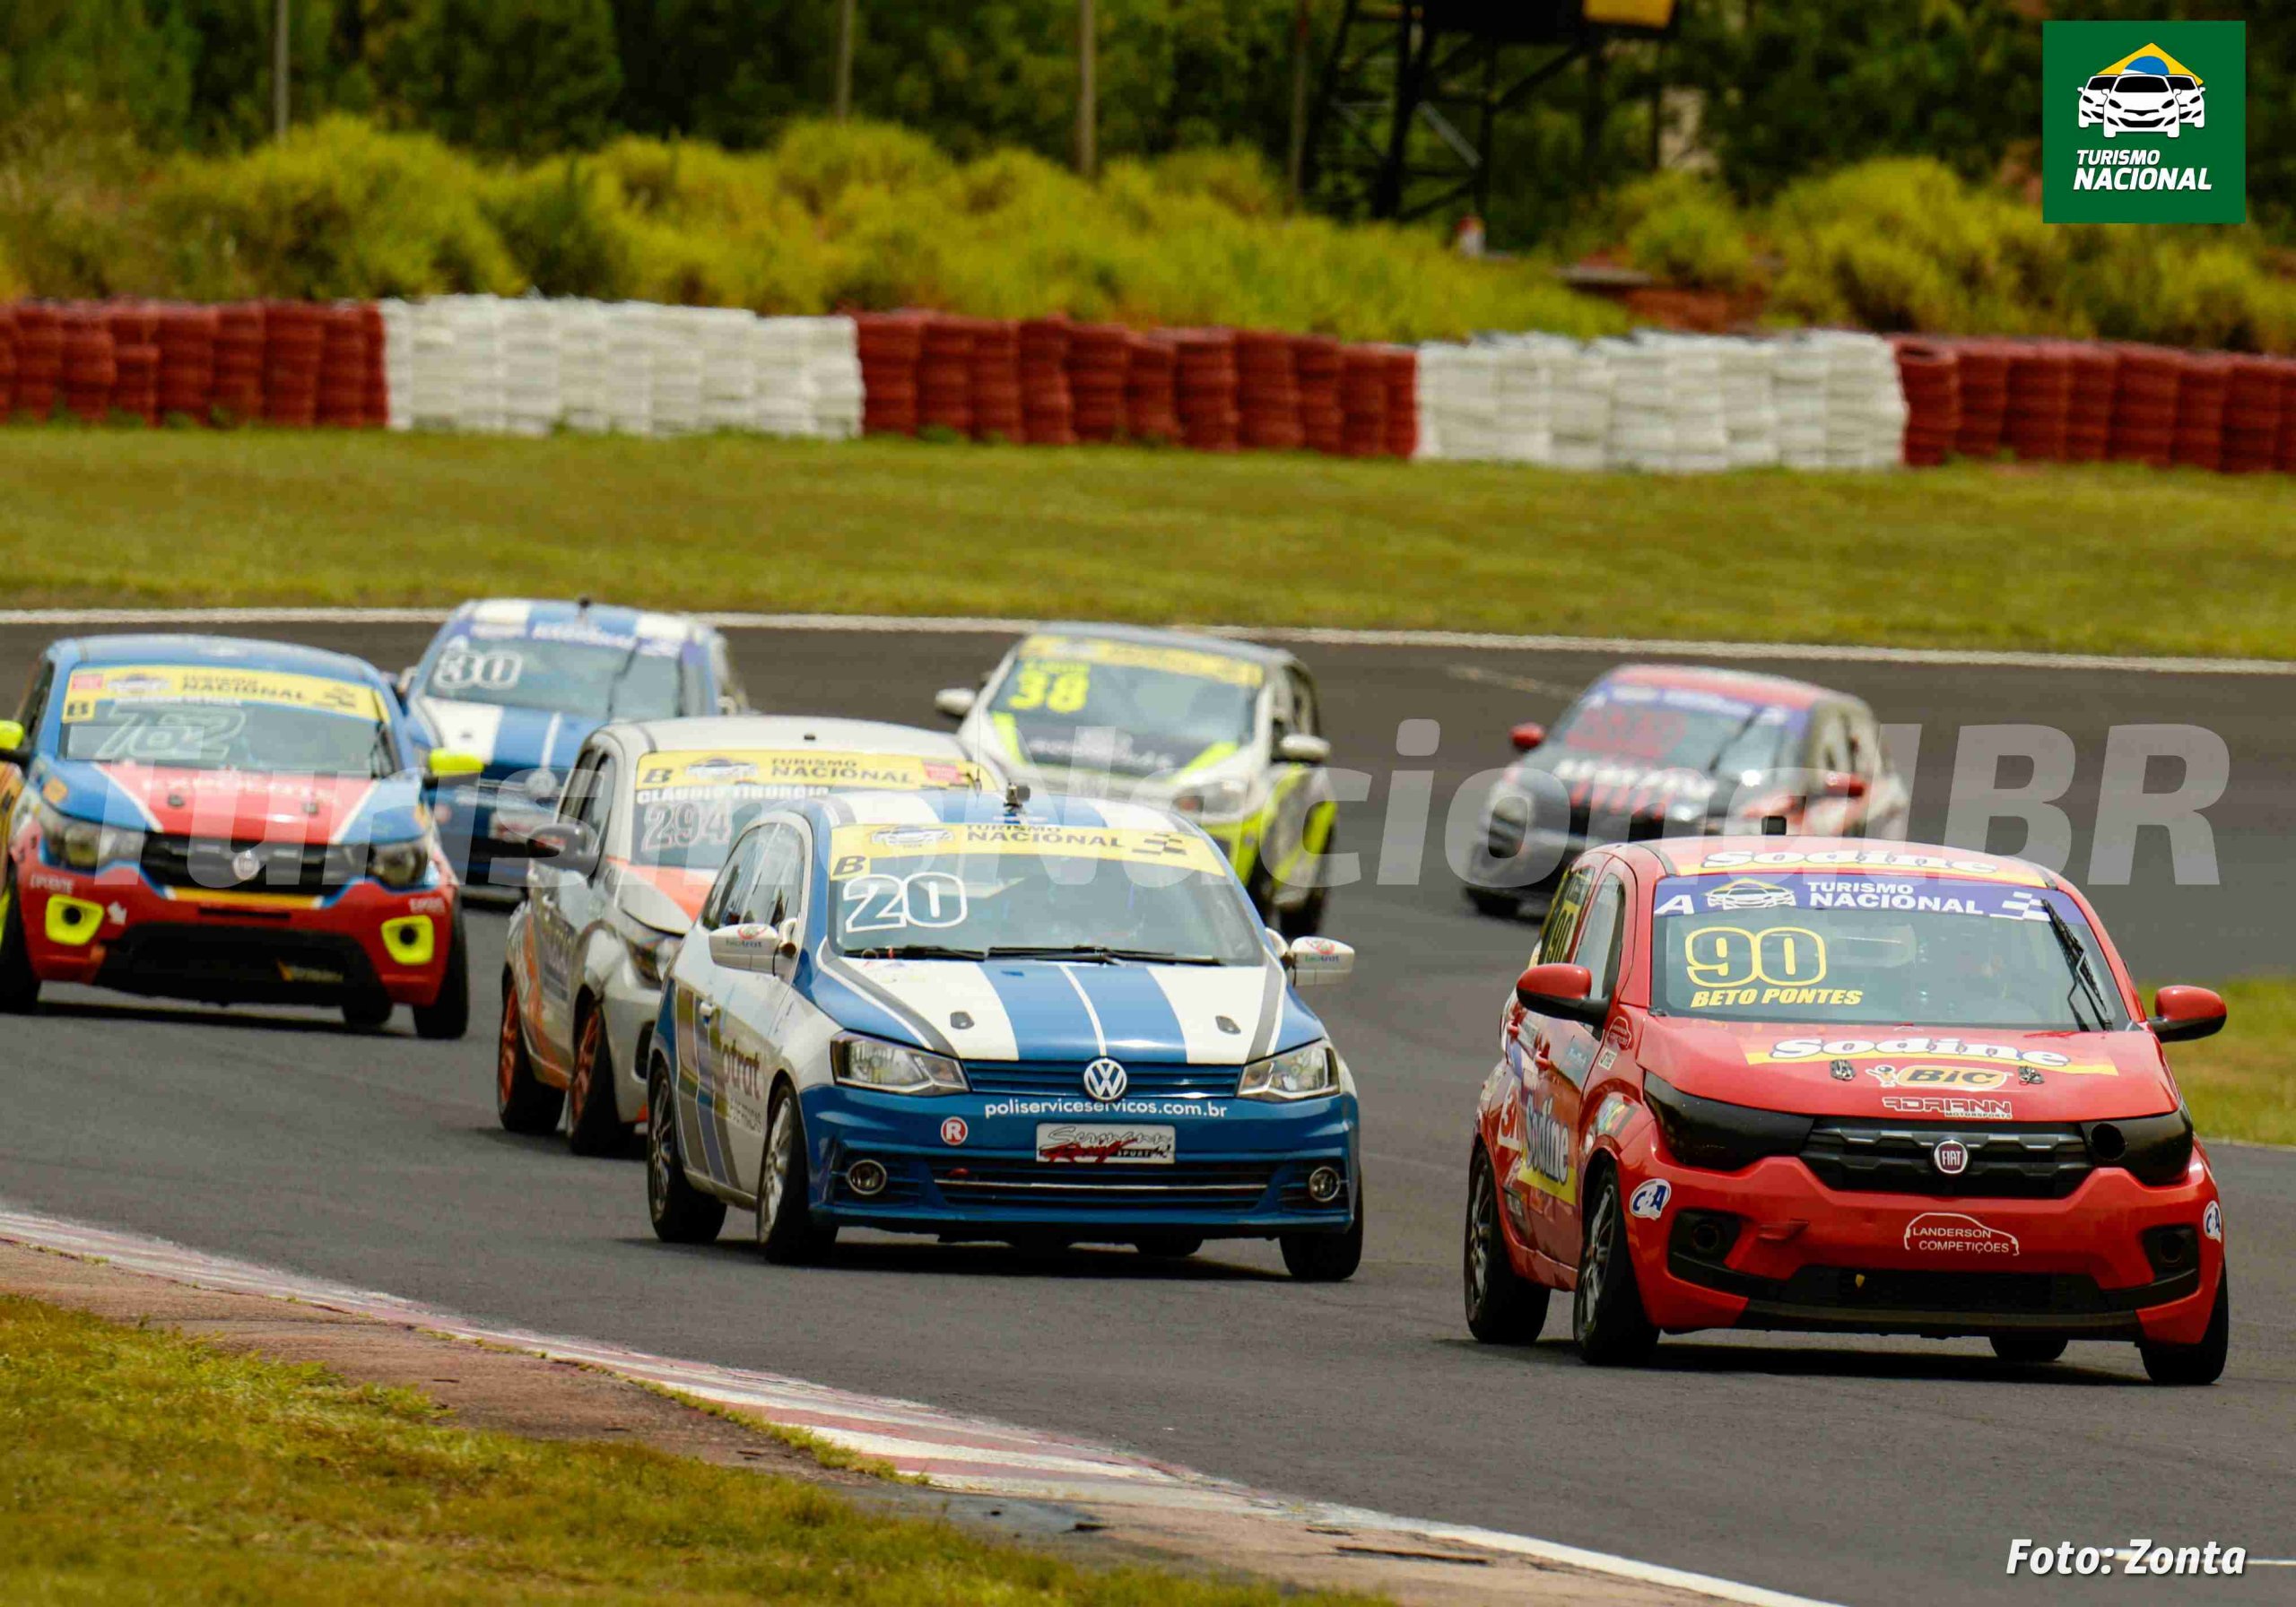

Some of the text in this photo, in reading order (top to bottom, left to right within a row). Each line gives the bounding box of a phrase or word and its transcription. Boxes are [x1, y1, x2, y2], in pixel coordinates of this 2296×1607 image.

[182, 682, 305, 700] NACIONAL
[1007, 671, 1089, 714] 38
[770, 757, 858, 769] TURISMO
[642, 769, 672, 784] B
[770, 767, 915, 785] NACIONAL
[640, 800, 734, 852] 294
[966, 830, 1124, 849] NACIONAL
[833, 856, 866, 876] B
[1808, 882, 1914, 894] TURISMO
[842, 871, 968, 933] 20
[1655, 891, 1984, 916] A NACIONAL
[1685, 926, 1827, 988] 90
[1691, 987, 1864, 1009] BETO PONTES
[1770, 1037, 2071, 1067] Sodine
[984, 1098, 1229, 1119] poliserviceservicos.com.br
[1941, 1150, 1962, 1166] FIAT
[1913, 1226, 1992, 1238] LANDERSON
[1918, 1239, 2010, 1255] COMPETIÇÕES
